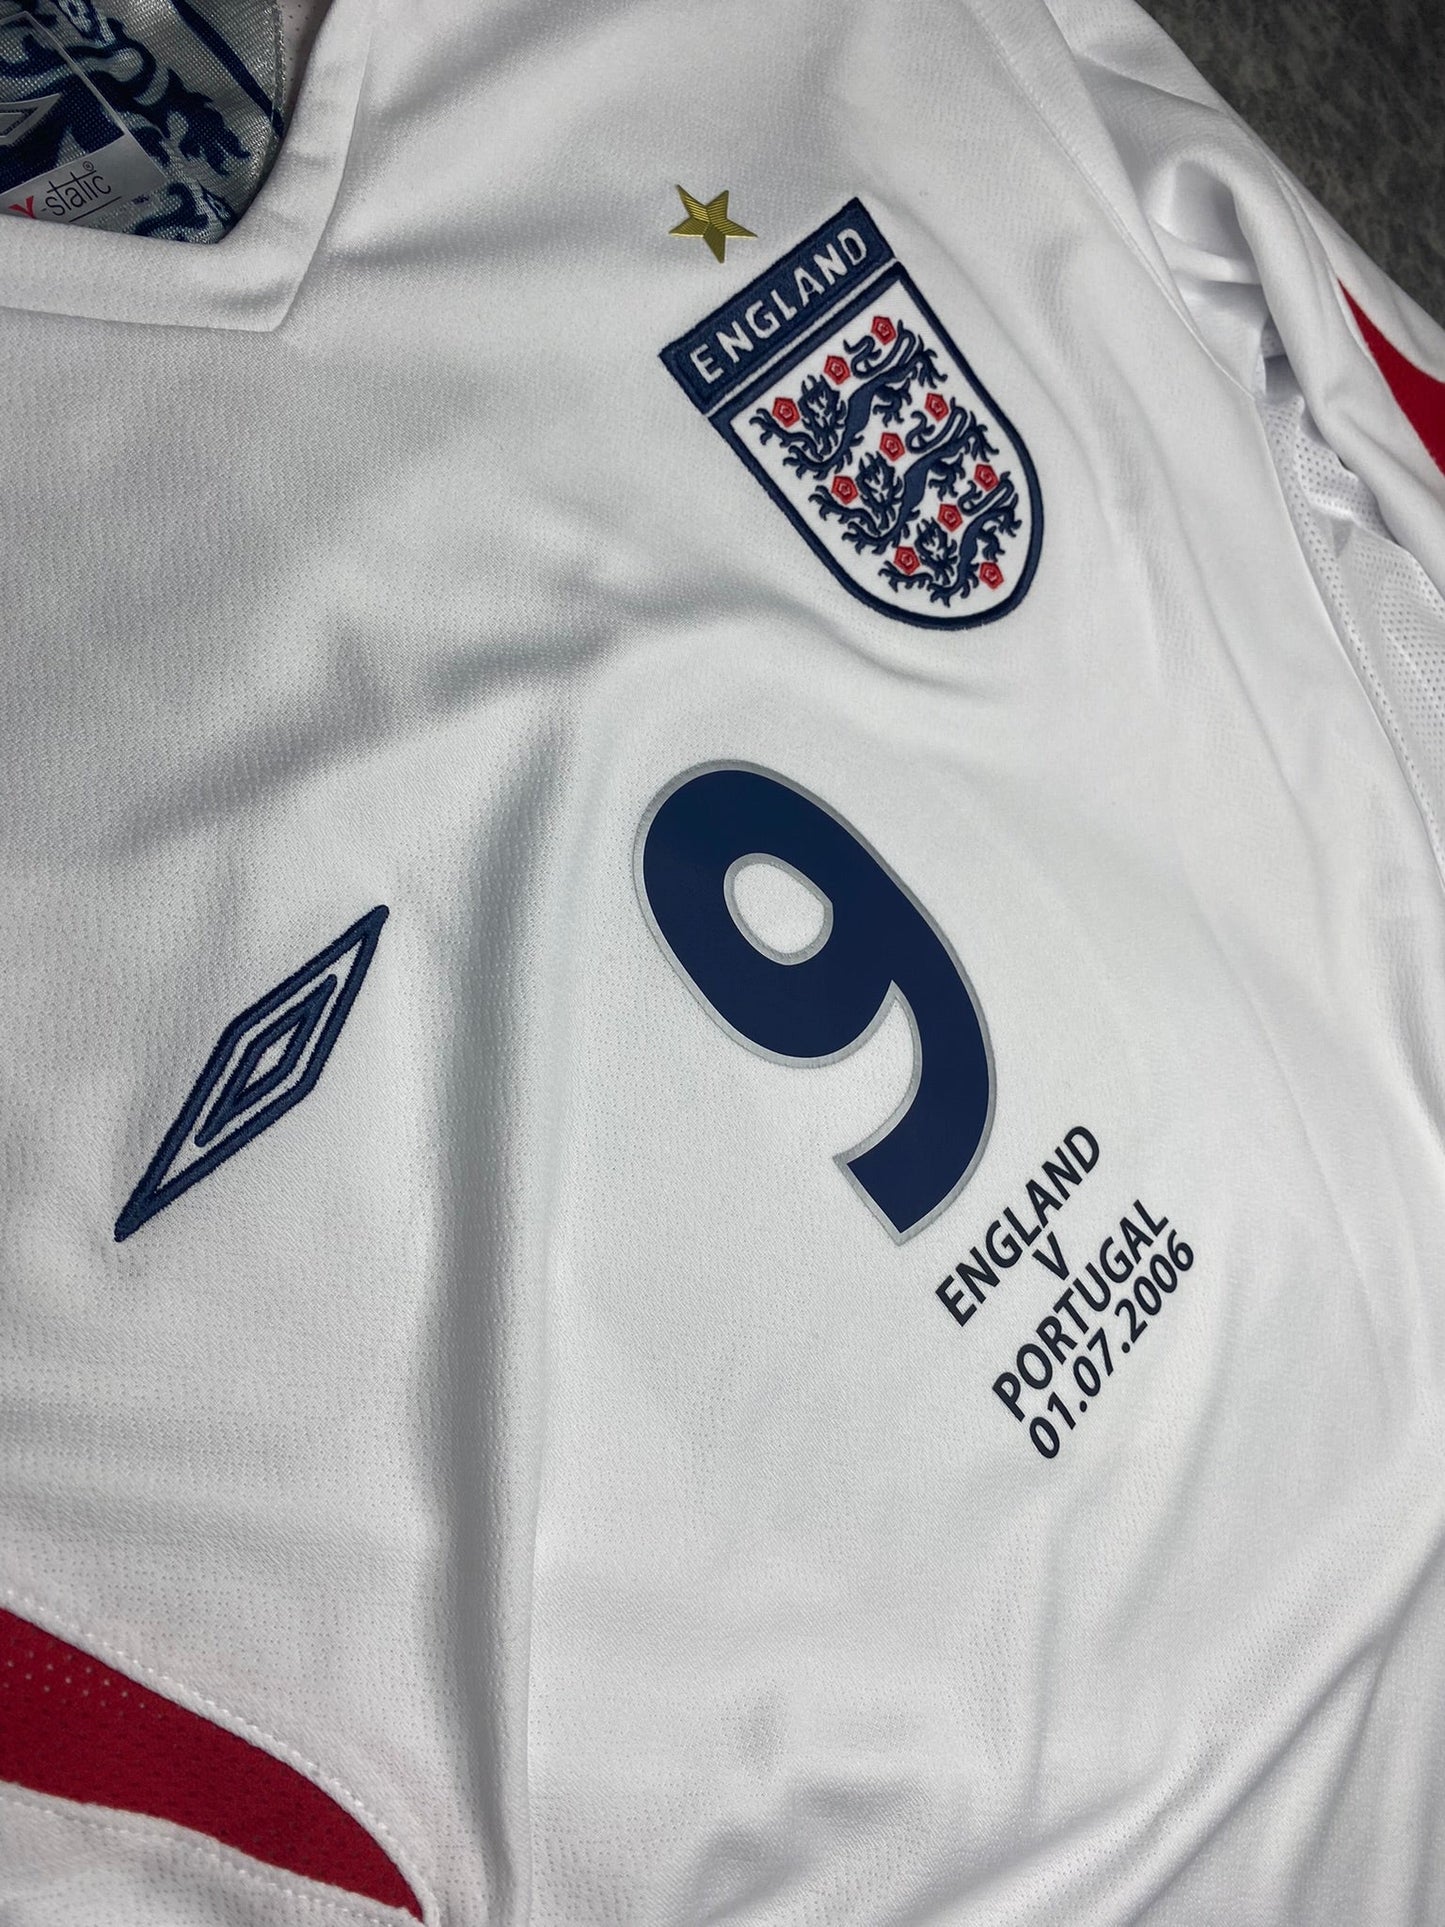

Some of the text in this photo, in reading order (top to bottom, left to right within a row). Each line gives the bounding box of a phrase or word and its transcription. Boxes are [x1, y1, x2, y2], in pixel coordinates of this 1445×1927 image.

[688, 227, 867, 383] ENGLAND
[632, 758, 998, 1247] 9
[935, 1126, 1100, 1327] ENGLAND
[992, 1199, 1169, 1422] PORTUGAL
[1032, 1231, 1070, 1281] V
[1029, 1229, 1194, 1459] 01.07.2006
